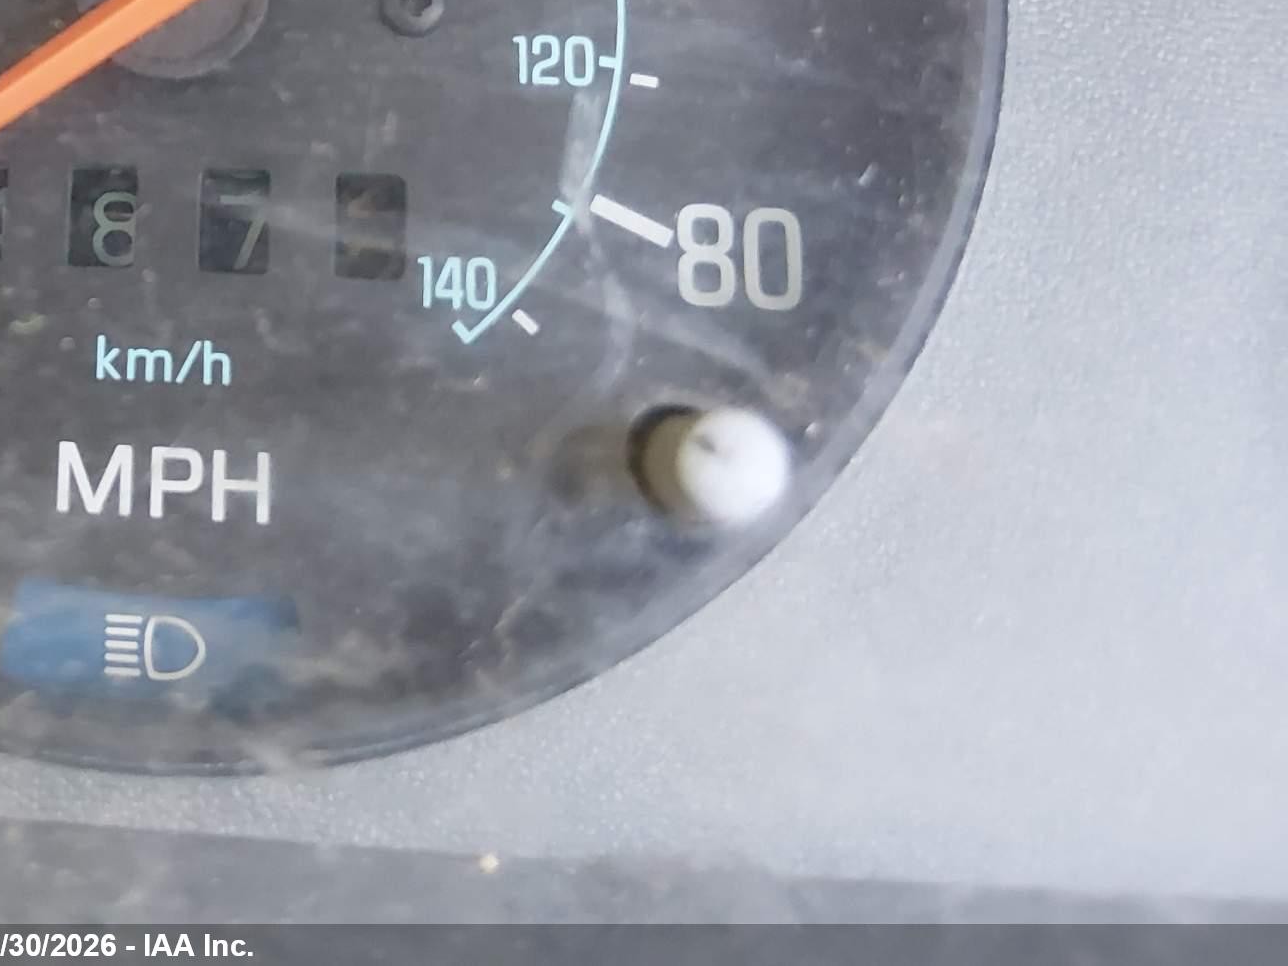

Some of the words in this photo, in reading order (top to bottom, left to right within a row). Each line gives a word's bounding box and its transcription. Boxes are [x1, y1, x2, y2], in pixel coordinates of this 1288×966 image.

[512, 34, 596, 87] 120
[417, 256, 499, 311] 140
[677, 202, 803, 311] 80
[95, 334, 232, 386] km/h
[56, 440, 271, 525] MPH
